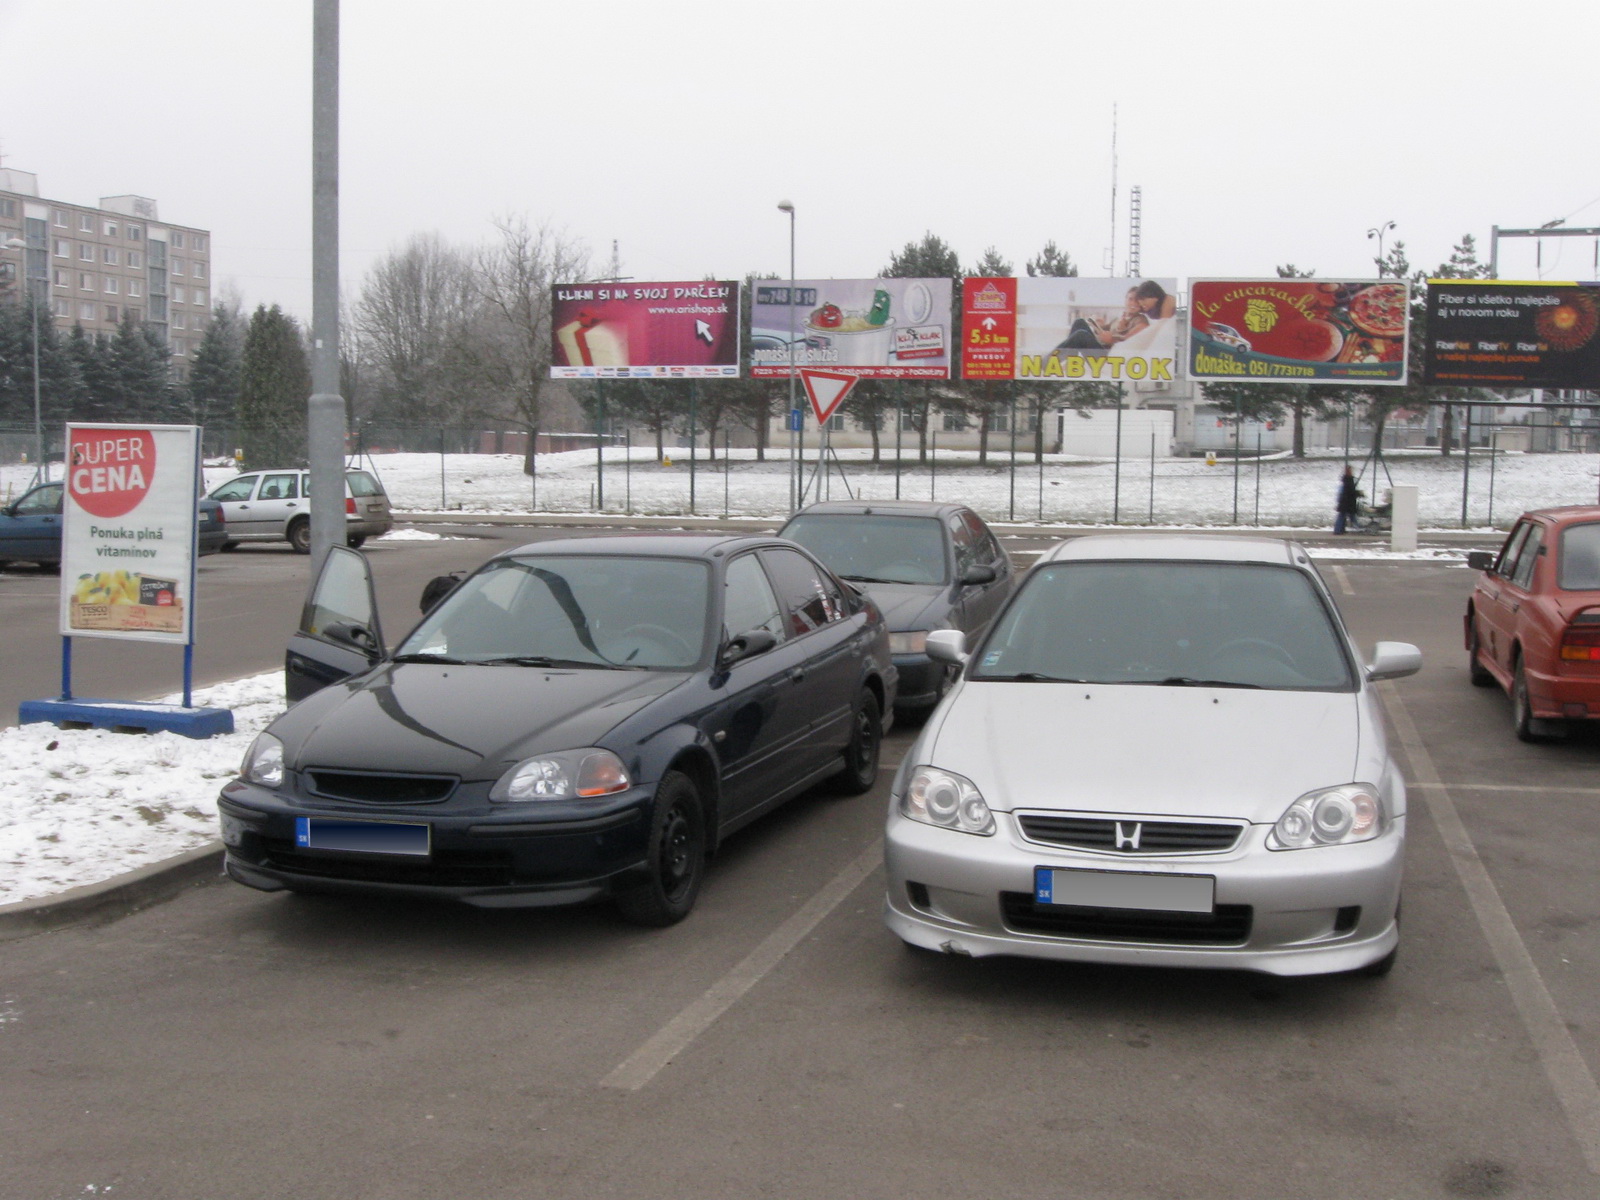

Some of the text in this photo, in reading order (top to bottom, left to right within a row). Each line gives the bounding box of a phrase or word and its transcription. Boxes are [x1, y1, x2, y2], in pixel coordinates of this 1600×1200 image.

[558, 284, 729, 301] KLIKNI SI NA SVOJ DARČEK!
[1438, 293, 1560, 307] Fiber si všetko najlepšie
[1195, 286, 1315, 321] la cucaracha
[1438, 307, 1520, 318] aj v novom roku
[1020, 350, 1174, 381] NÁBYTOK
[72, 437, 145, 466] SUPER
[73, 464, 147, 495] CENA
[90, 525, 164, 542] Ponuka plná
[1038, 889, 1051, 898] SK
